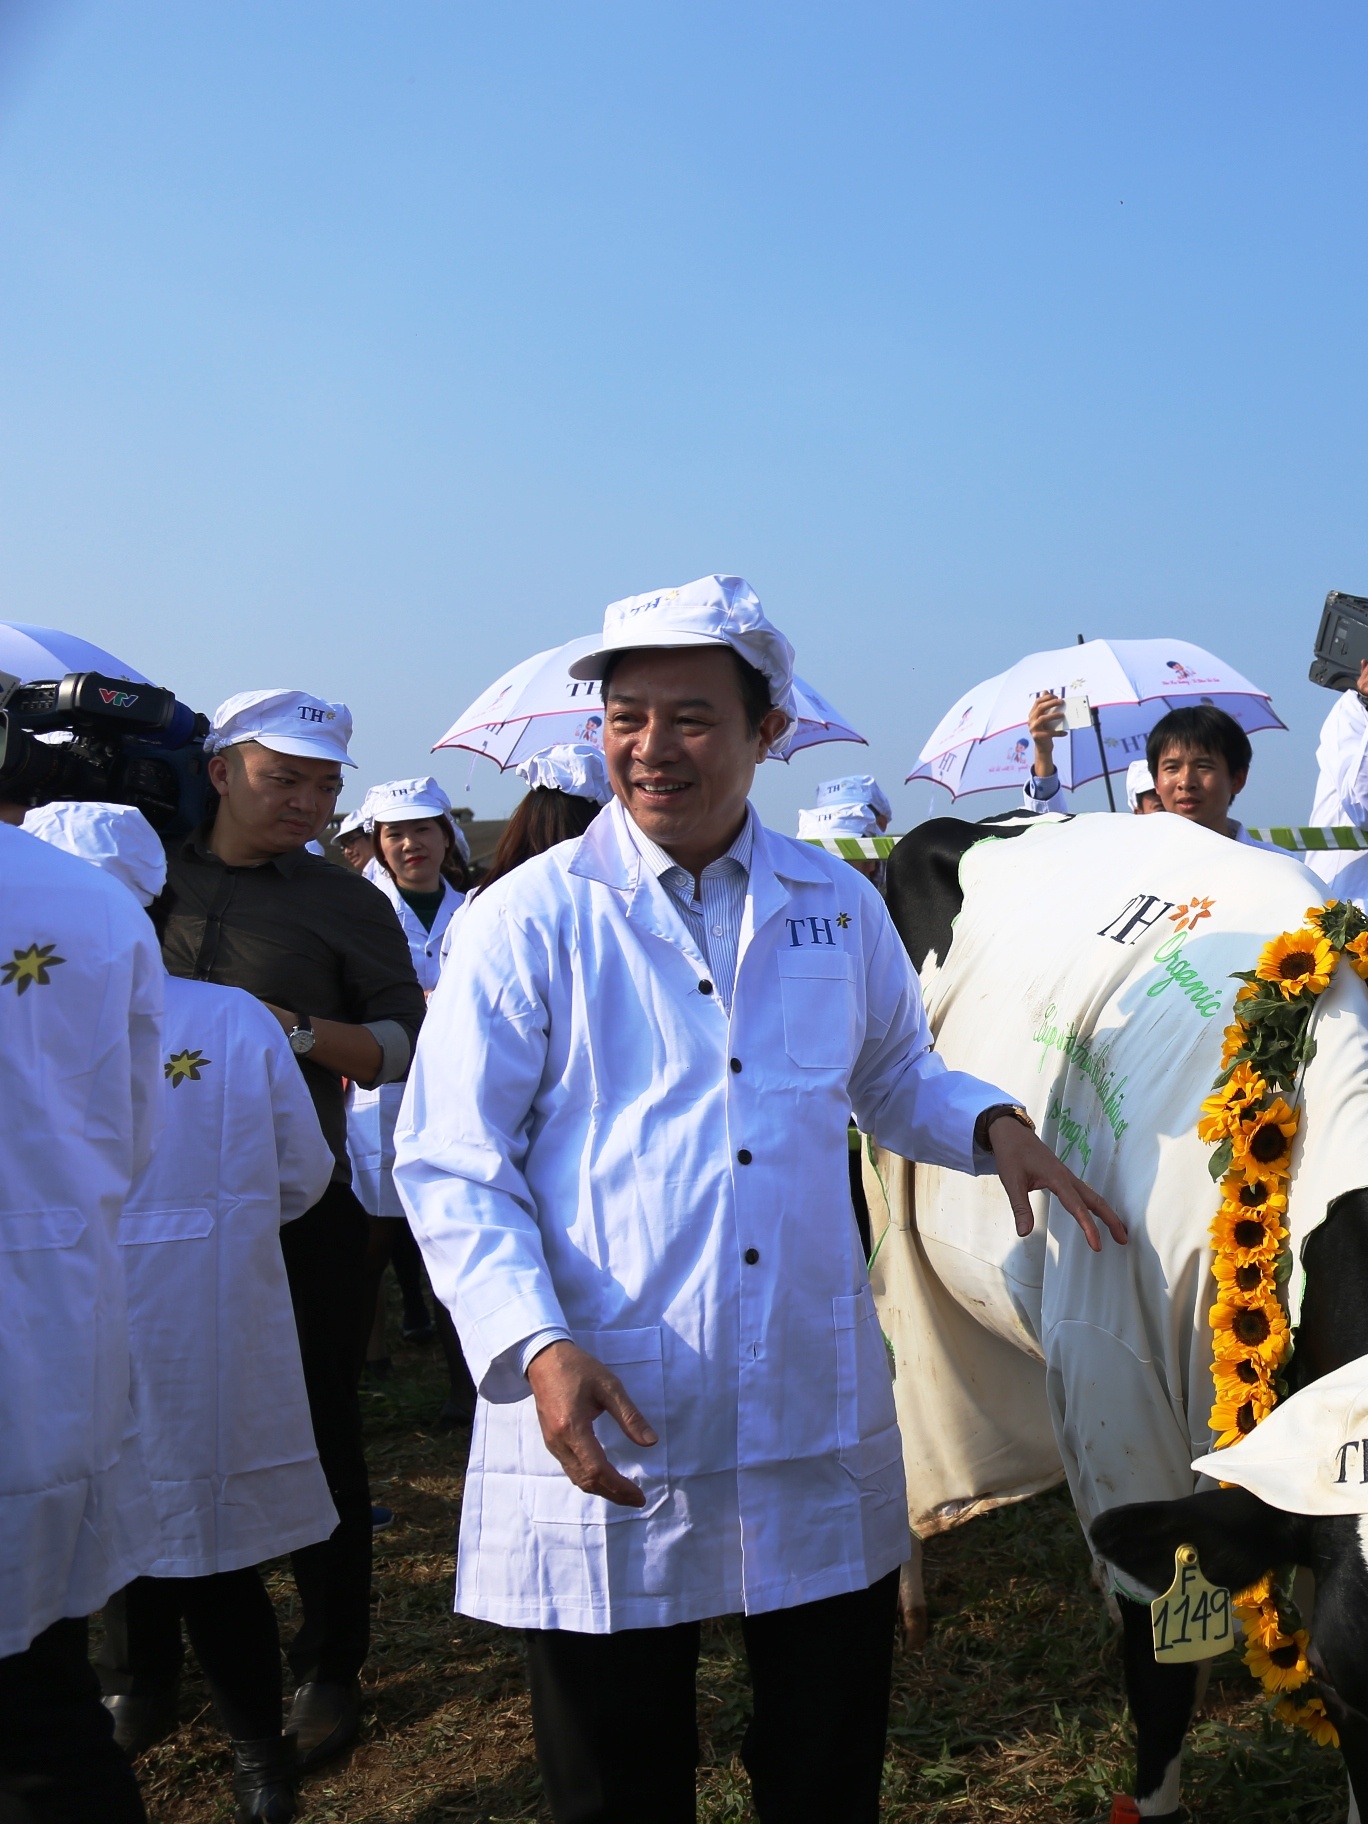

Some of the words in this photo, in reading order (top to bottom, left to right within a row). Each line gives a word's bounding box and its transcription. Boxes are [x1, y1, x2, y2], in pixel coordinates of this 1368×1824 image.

[630, 596, 662, 616] TH
[99, 688, 139, 708] VTV
[298, 705, 325, 723] TH
[391, 788, 408, 797] TH
[827, 784, 840, 793] TH
[817, 813, 832, 821] TH
[1097, 894, 1174, 945] TH
[785, 916, 837, 947] TH
[1146, 931, 1222, 1018] Organic
[1181, 1565, 1197, 1596] F
[1153, 1588, 1230, 1651] 1149
